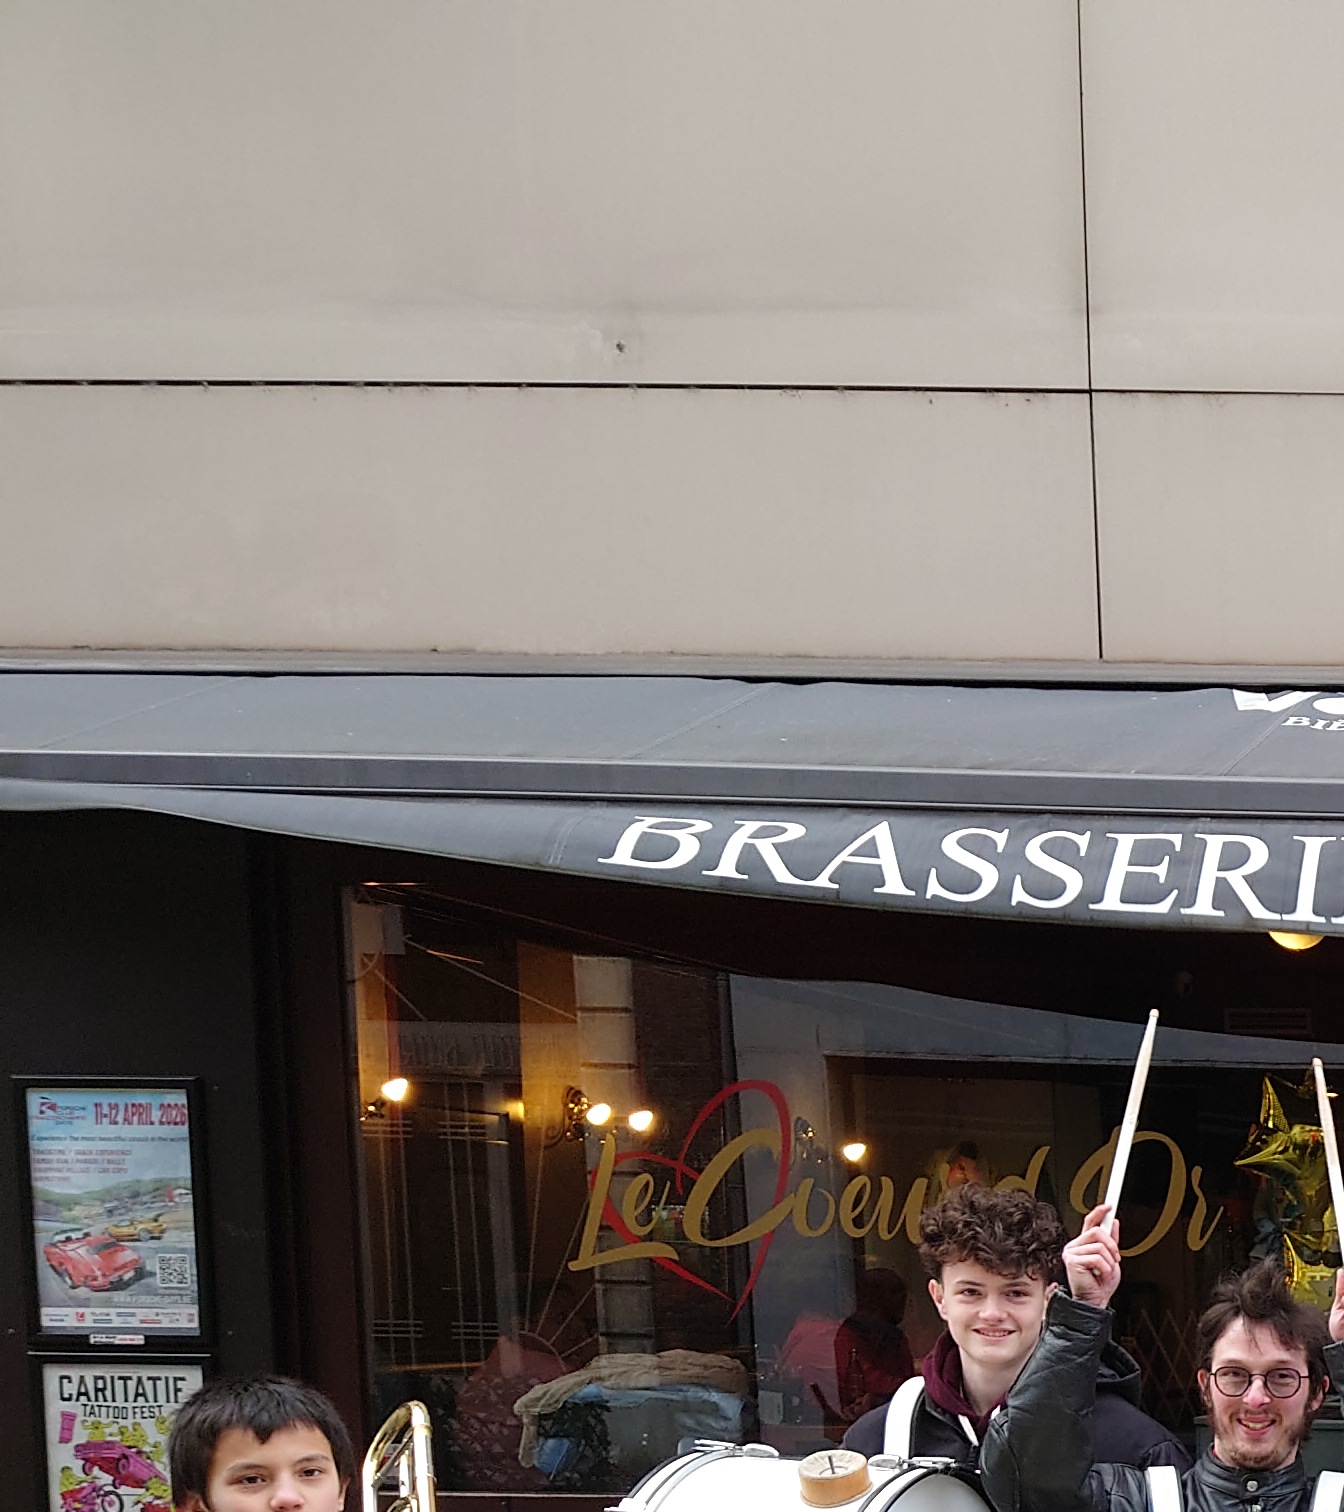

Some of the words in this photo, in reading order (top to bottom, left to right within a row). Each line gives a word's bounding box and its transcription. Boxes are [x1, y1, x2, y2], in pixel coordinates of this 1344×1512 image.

[94, 1102, 119, 1125] 11-12
[122, 1102, 155, 1126] APRIL
[158, 1103, 188, 1126] 2026
[568, 1133, 679, 1270] Le
[681, 1127, 953, 1247] Coeu
[1068, 1125, 1224, 1258] Or
[59, 1375, 187, 1403] CARITATIF
[81, 1404, 128, 1420] TATTOO
[131, 1405, 164, 1420] FEST
